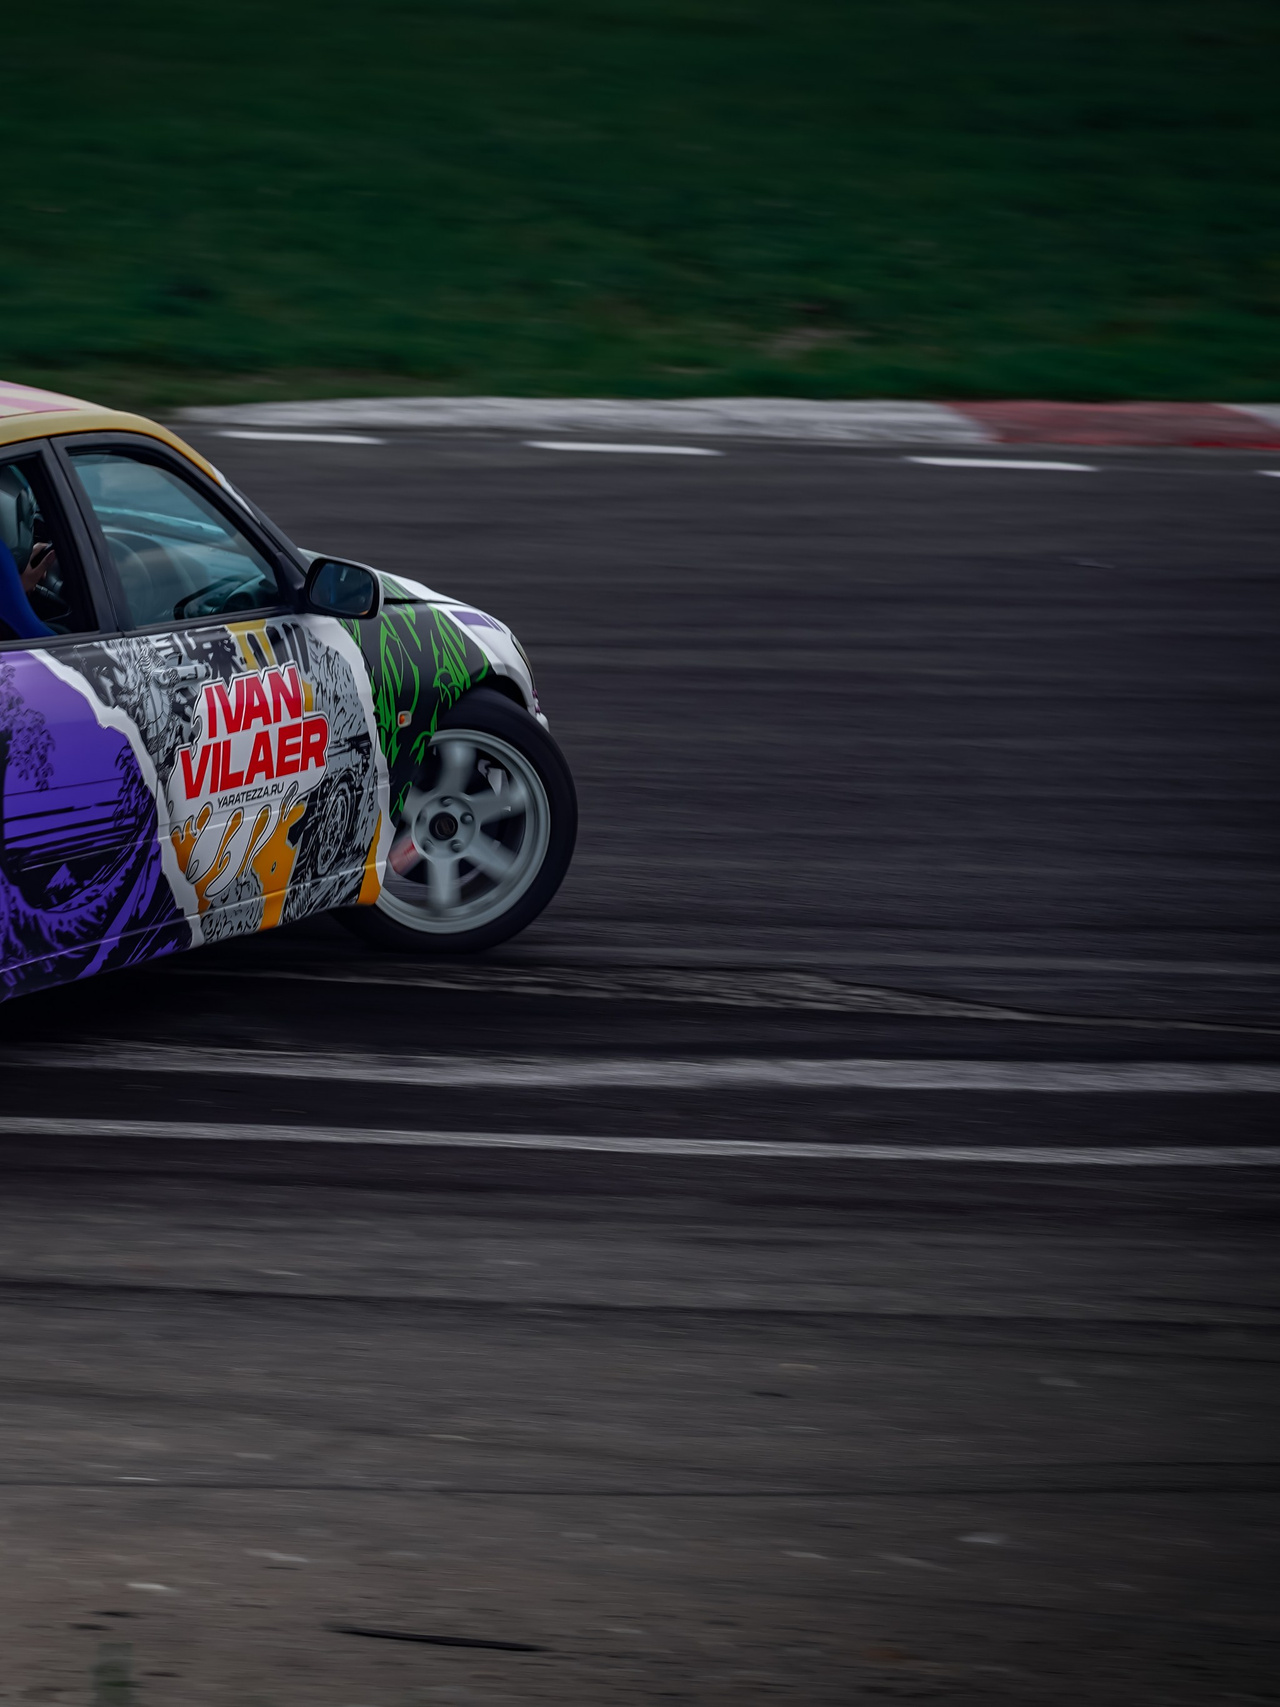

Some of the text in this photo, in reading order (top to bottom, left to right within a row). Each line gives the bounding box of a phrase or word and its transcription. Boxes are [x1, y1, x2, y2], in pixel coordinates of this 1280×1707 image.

[205, 667, 302, 739] IVAN
[180, 717, 328, 800] VILAER
[218, 782, 284, 809] YARATEZZA.RU
